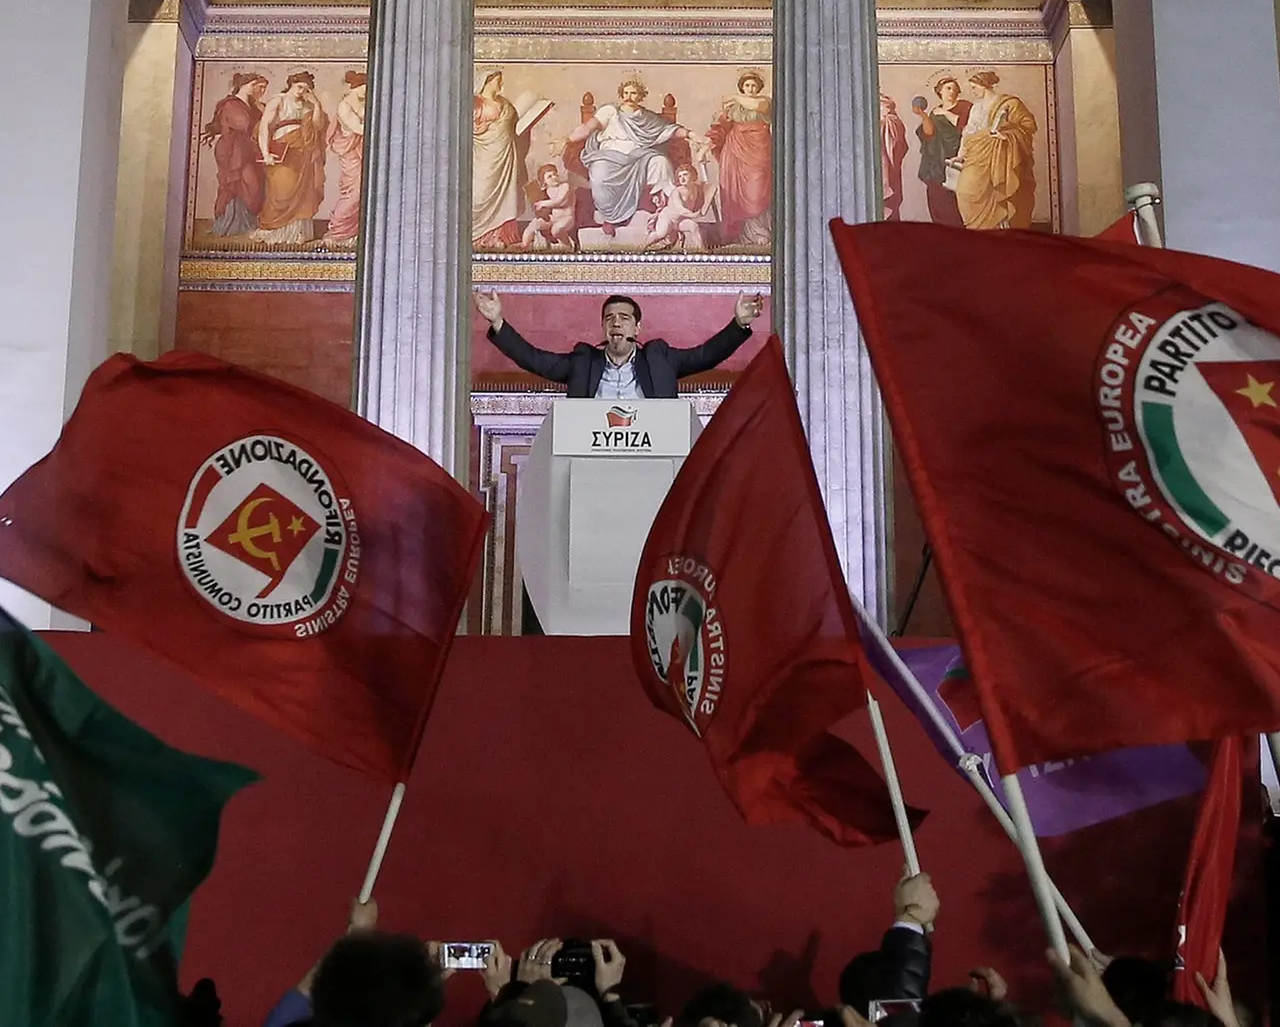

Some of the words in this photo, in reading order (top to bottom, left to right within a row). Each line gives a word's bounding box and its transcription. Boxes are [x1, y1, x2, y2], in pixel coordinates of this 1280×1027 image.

[1099, 310, 1157, 454] EUROPEA
[1142, 309, 1238, 399] PARTITO
[591, 431, 652, 447] ΣΥΡΙΖΑ
